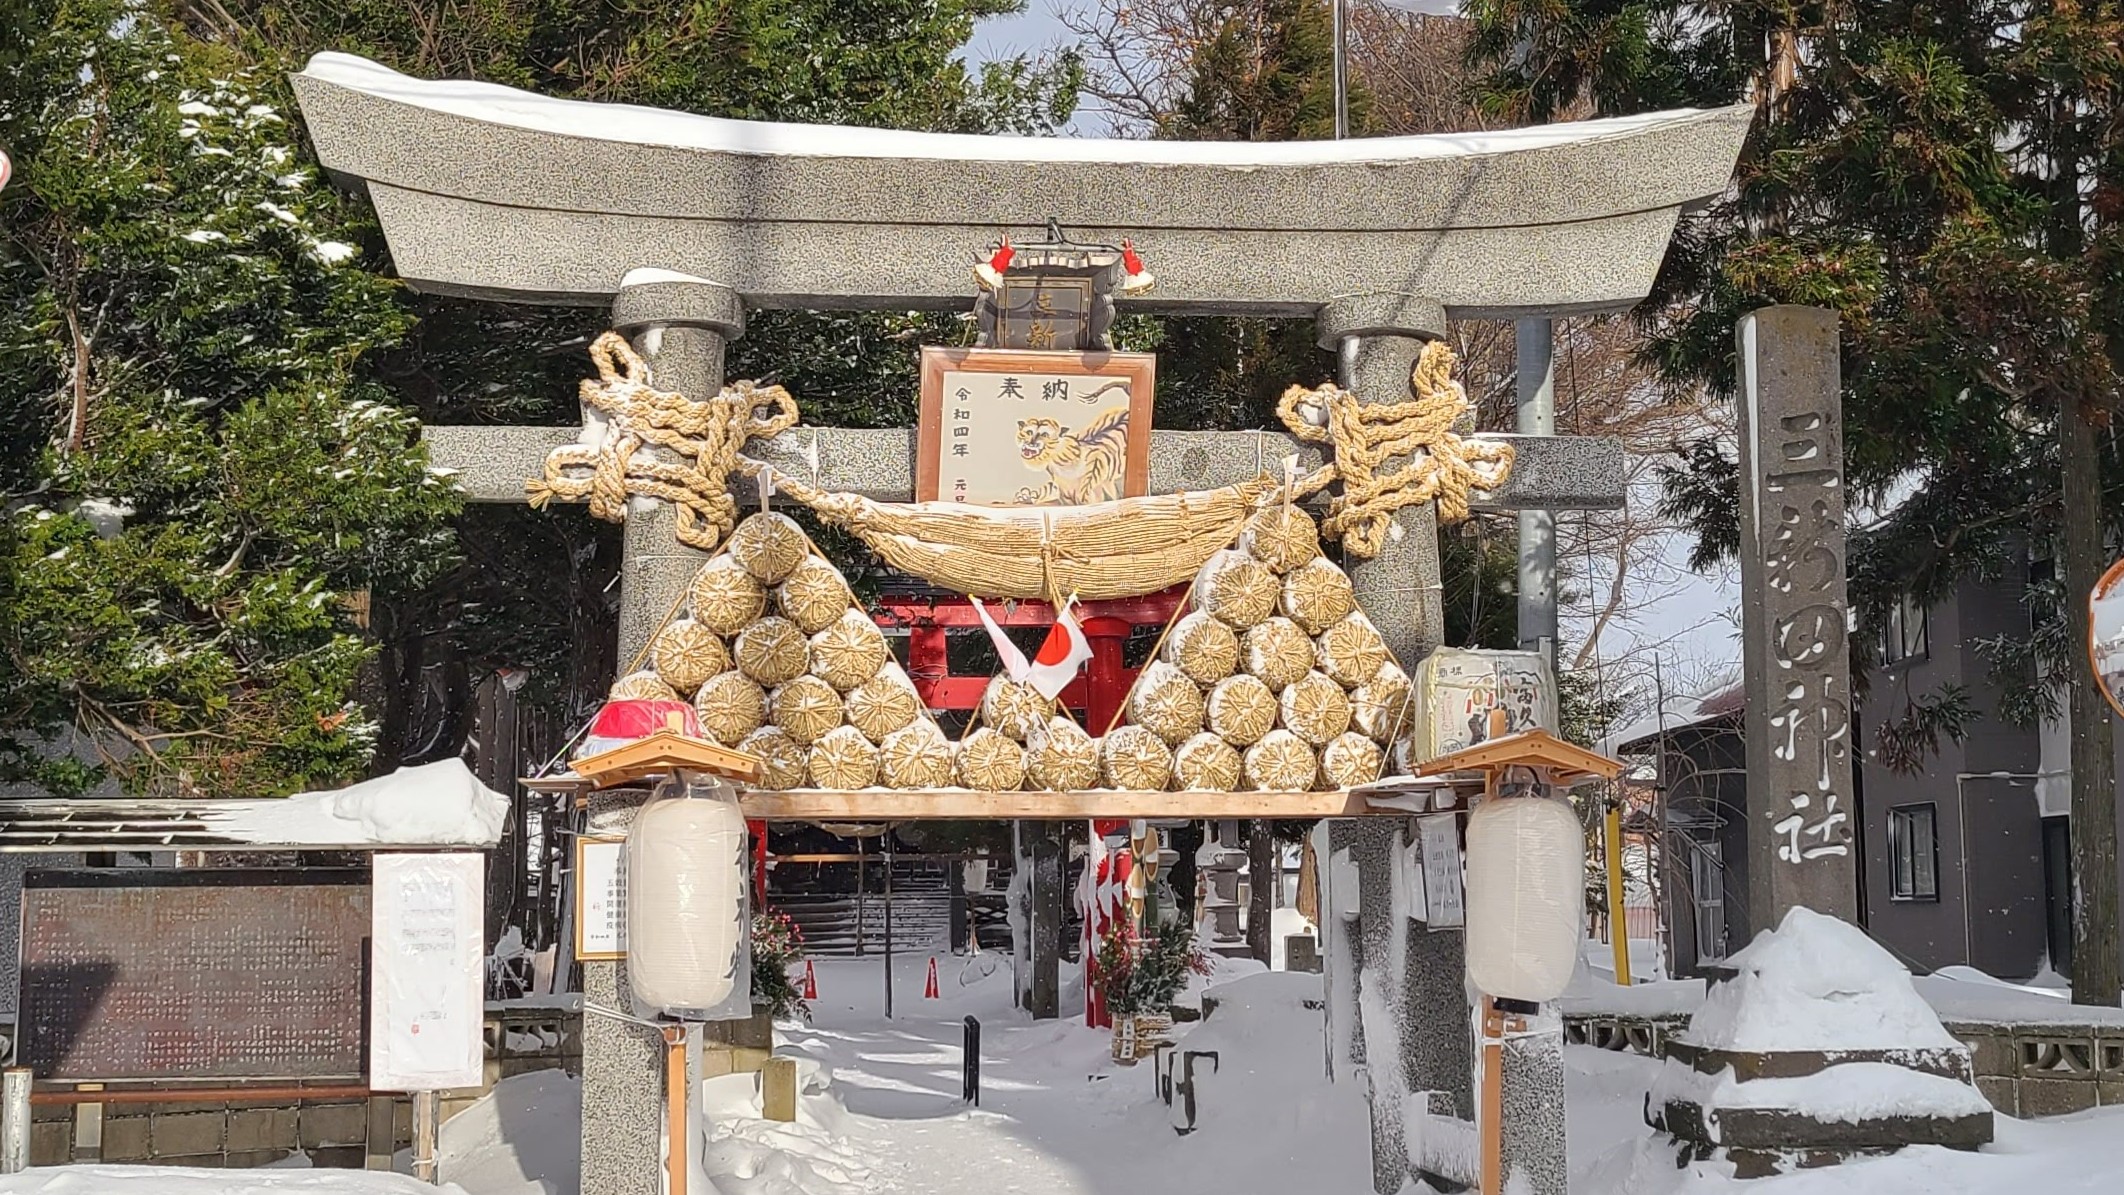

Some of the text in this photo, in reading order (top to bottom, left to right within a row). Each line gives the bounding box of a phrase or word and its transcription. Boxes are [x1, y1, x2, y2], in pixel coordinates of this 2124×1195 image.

[997, 377, 1069, 401] 奉納
[952, 387, 971, 457] 令和四年
